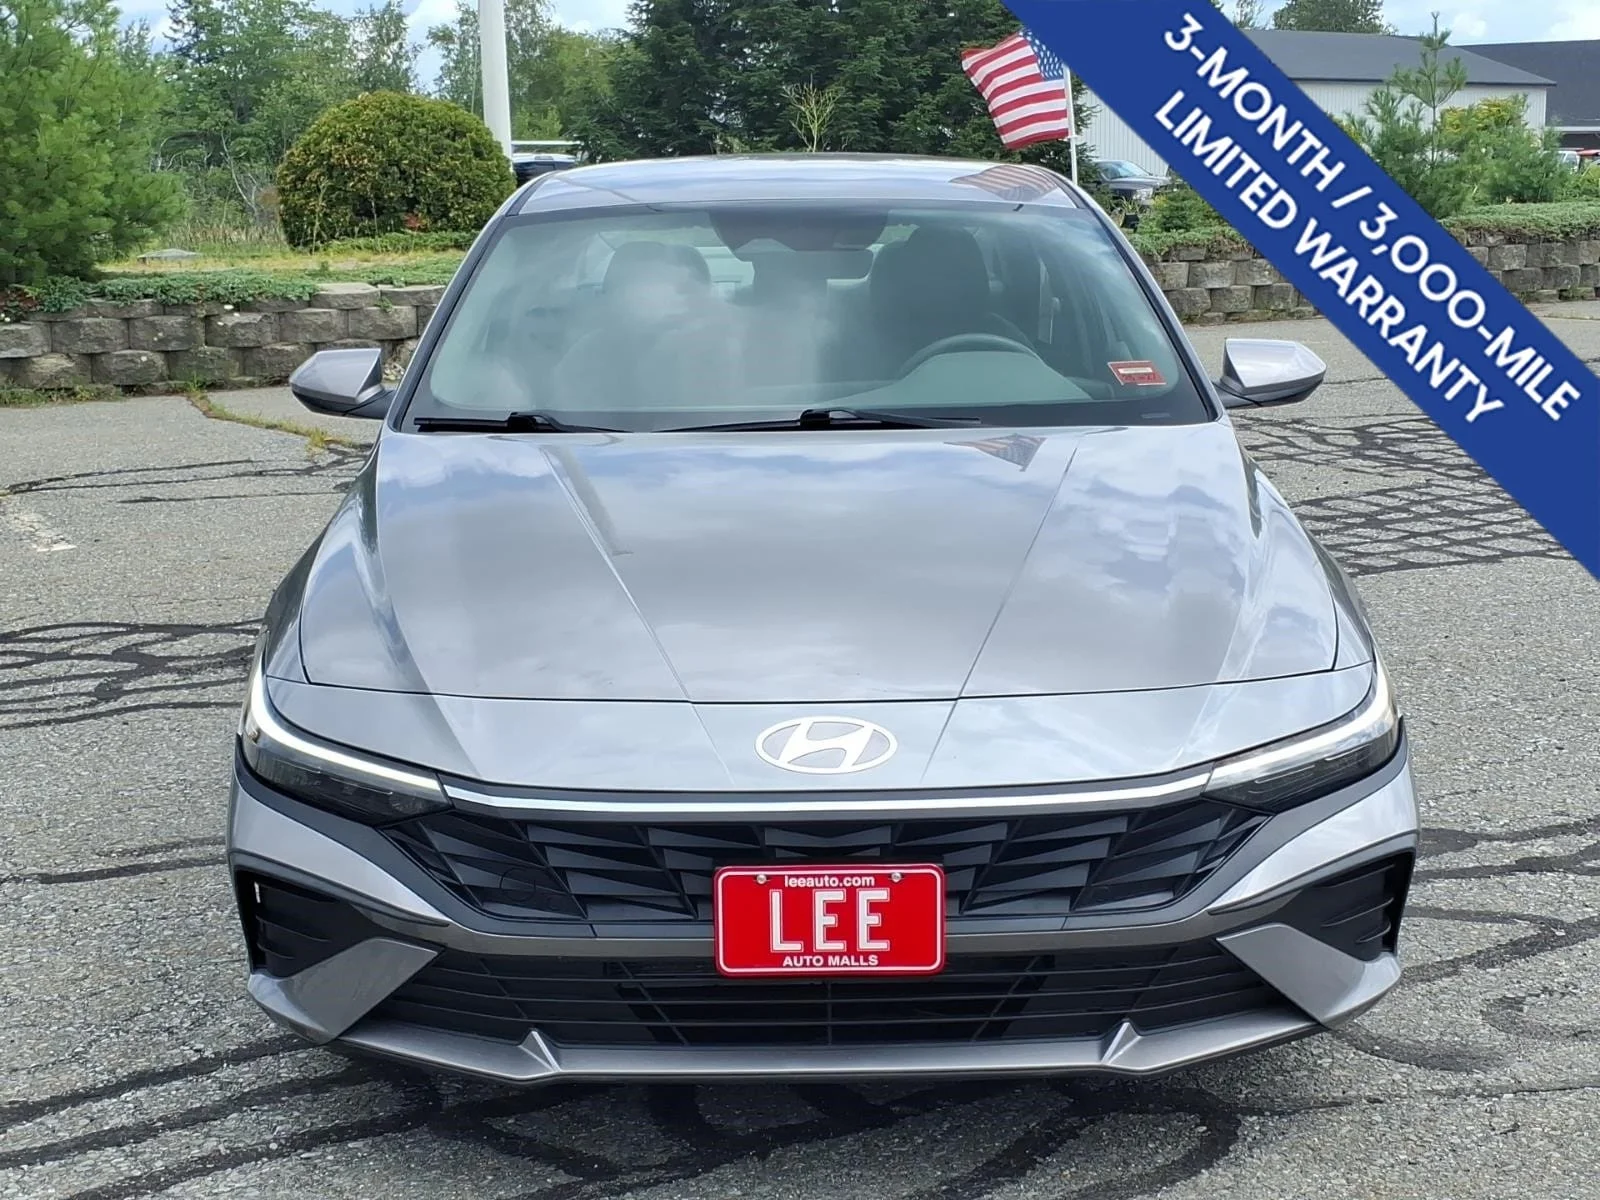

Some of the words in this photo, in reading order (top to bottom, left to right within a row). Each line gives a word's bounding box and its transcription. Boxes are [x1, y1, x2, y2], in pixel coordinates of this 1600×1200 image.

[784, 874, 876, 888] leeauto.com
[769, 887, 891, 953] LEE
[782, 955, 825, 967] AUTO
[827, 954, 880, 966] MALLS
